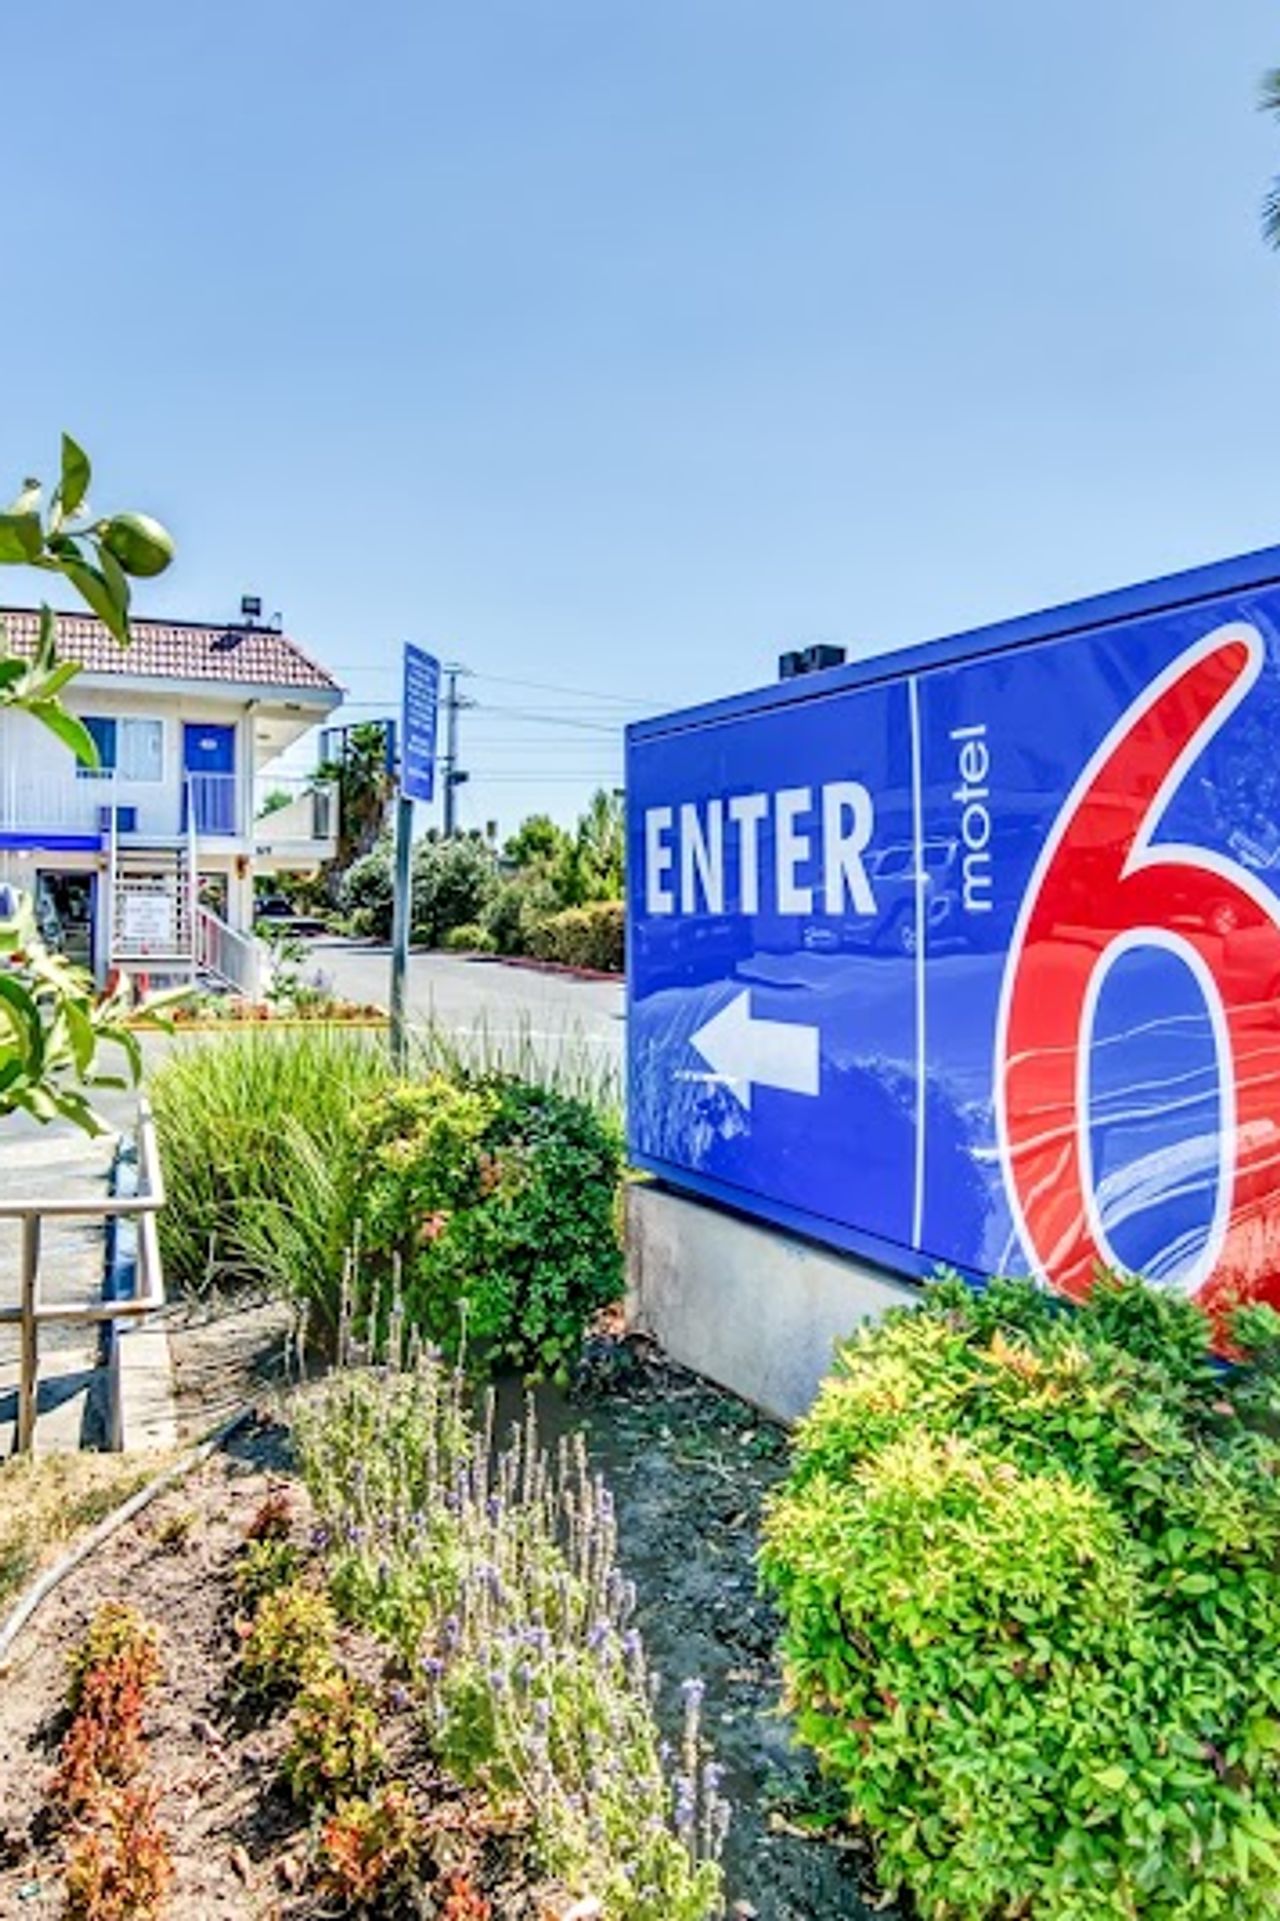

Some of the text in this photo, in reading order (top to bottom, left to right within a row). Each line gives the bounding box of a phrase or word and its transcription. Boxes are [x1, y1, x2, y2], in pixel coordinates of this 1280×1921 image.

[644, 782, 877, 916] ENTER
[951, 622, 1280, 1304] motel 6
